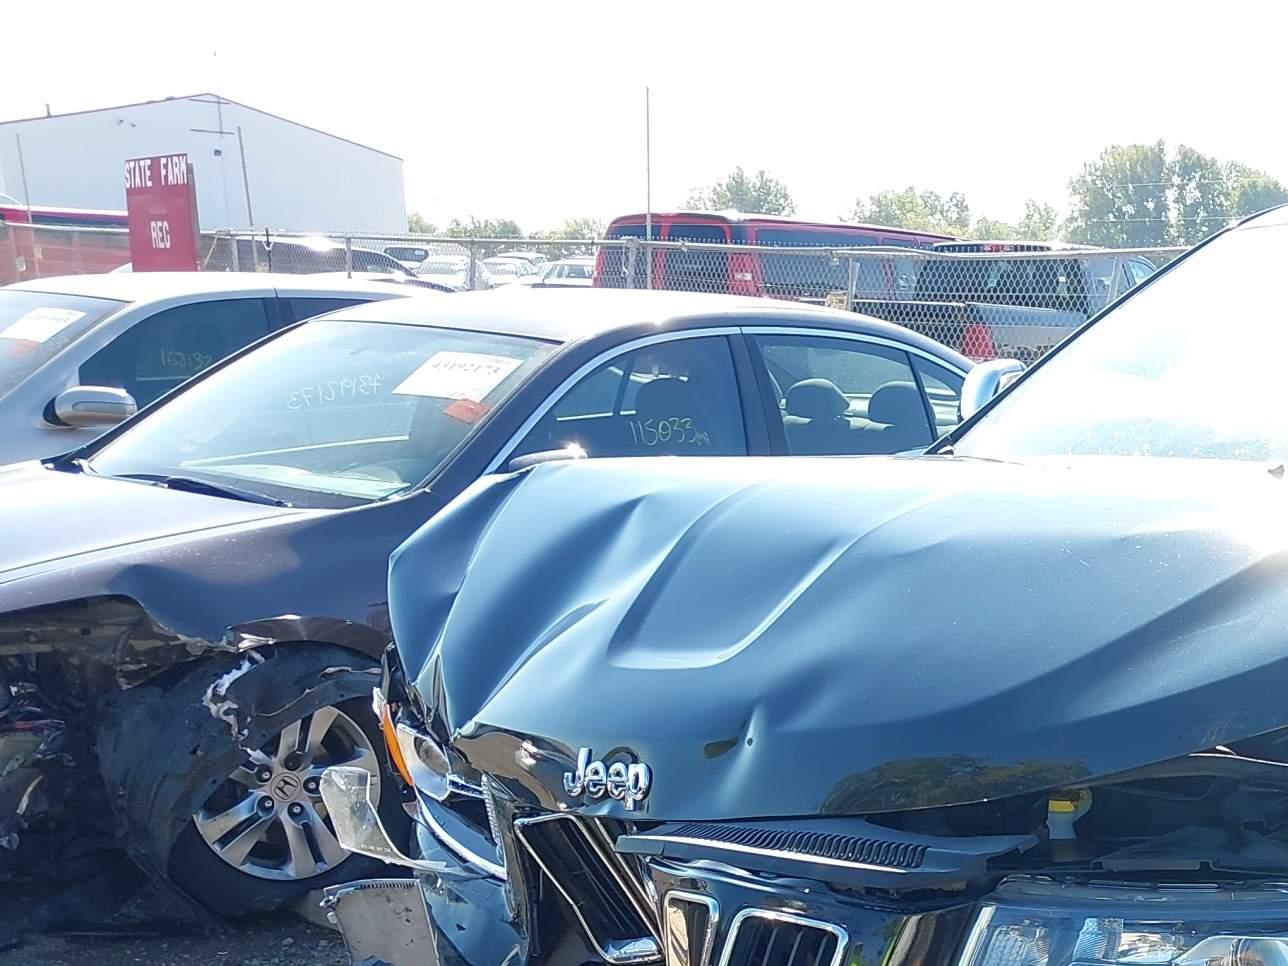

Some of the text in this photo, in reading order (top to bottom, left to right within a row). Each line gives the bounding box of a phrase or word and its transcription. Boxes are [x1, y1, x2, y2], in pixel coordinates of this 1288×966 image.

[124, 155, 188, 189] STATE FARM
[150, 220, 171, 249] REC
[563, 747, 652, 811] Jeep
